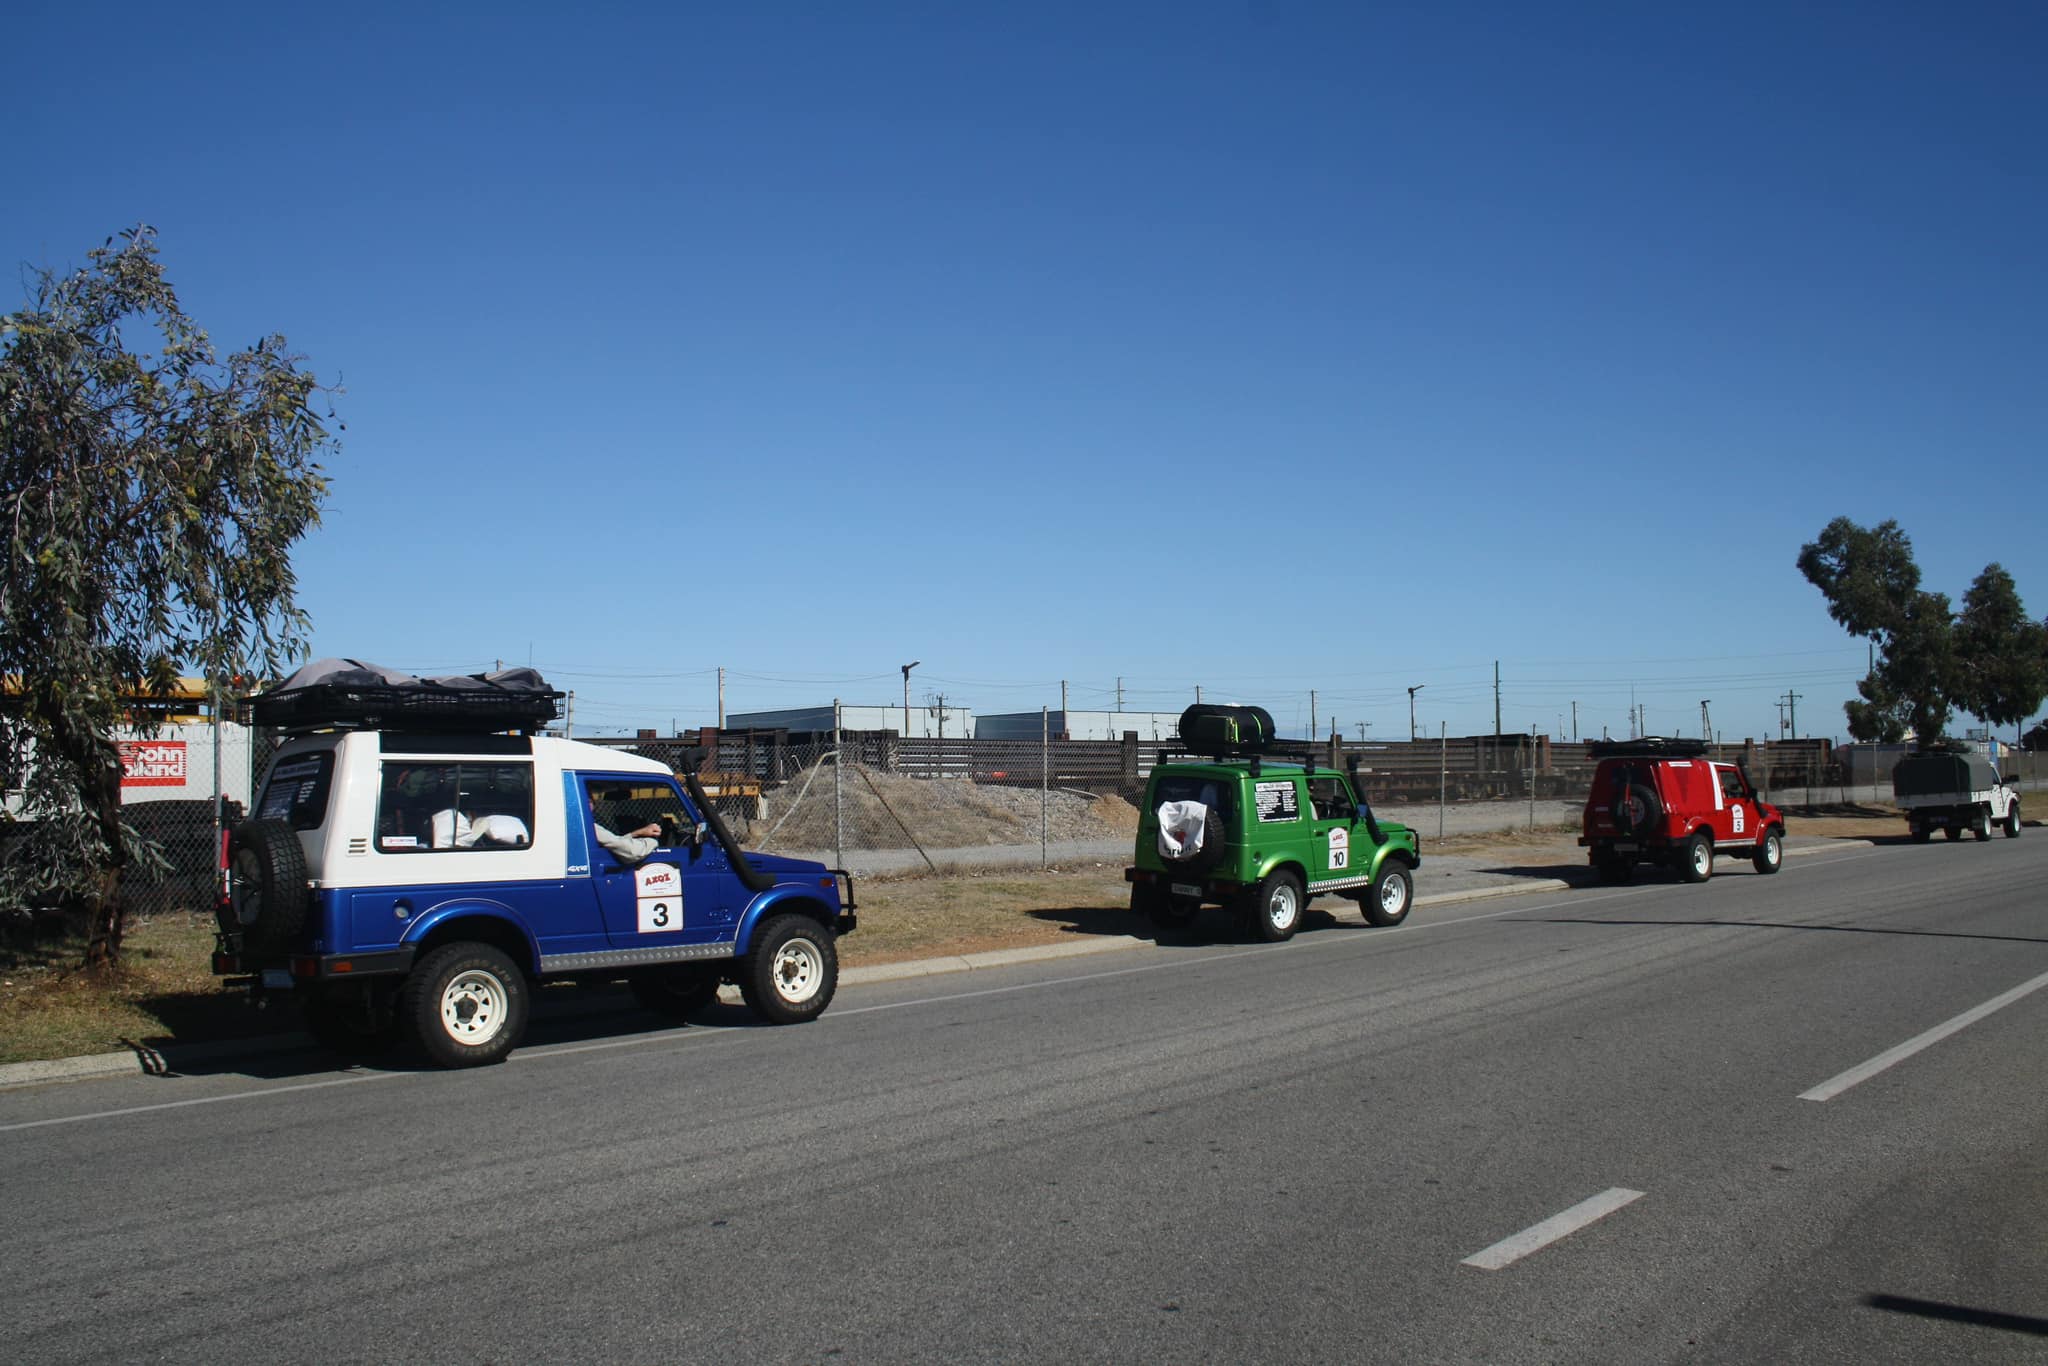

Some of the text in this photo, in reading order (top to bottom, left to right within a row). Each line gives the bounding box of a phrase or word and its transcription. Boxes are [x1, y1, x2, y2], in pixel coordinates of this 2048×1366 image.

[124, 761, 184, 777] olland
[1333, 851, 1345, 867] 10
[653, 903, 668, 927] 3
